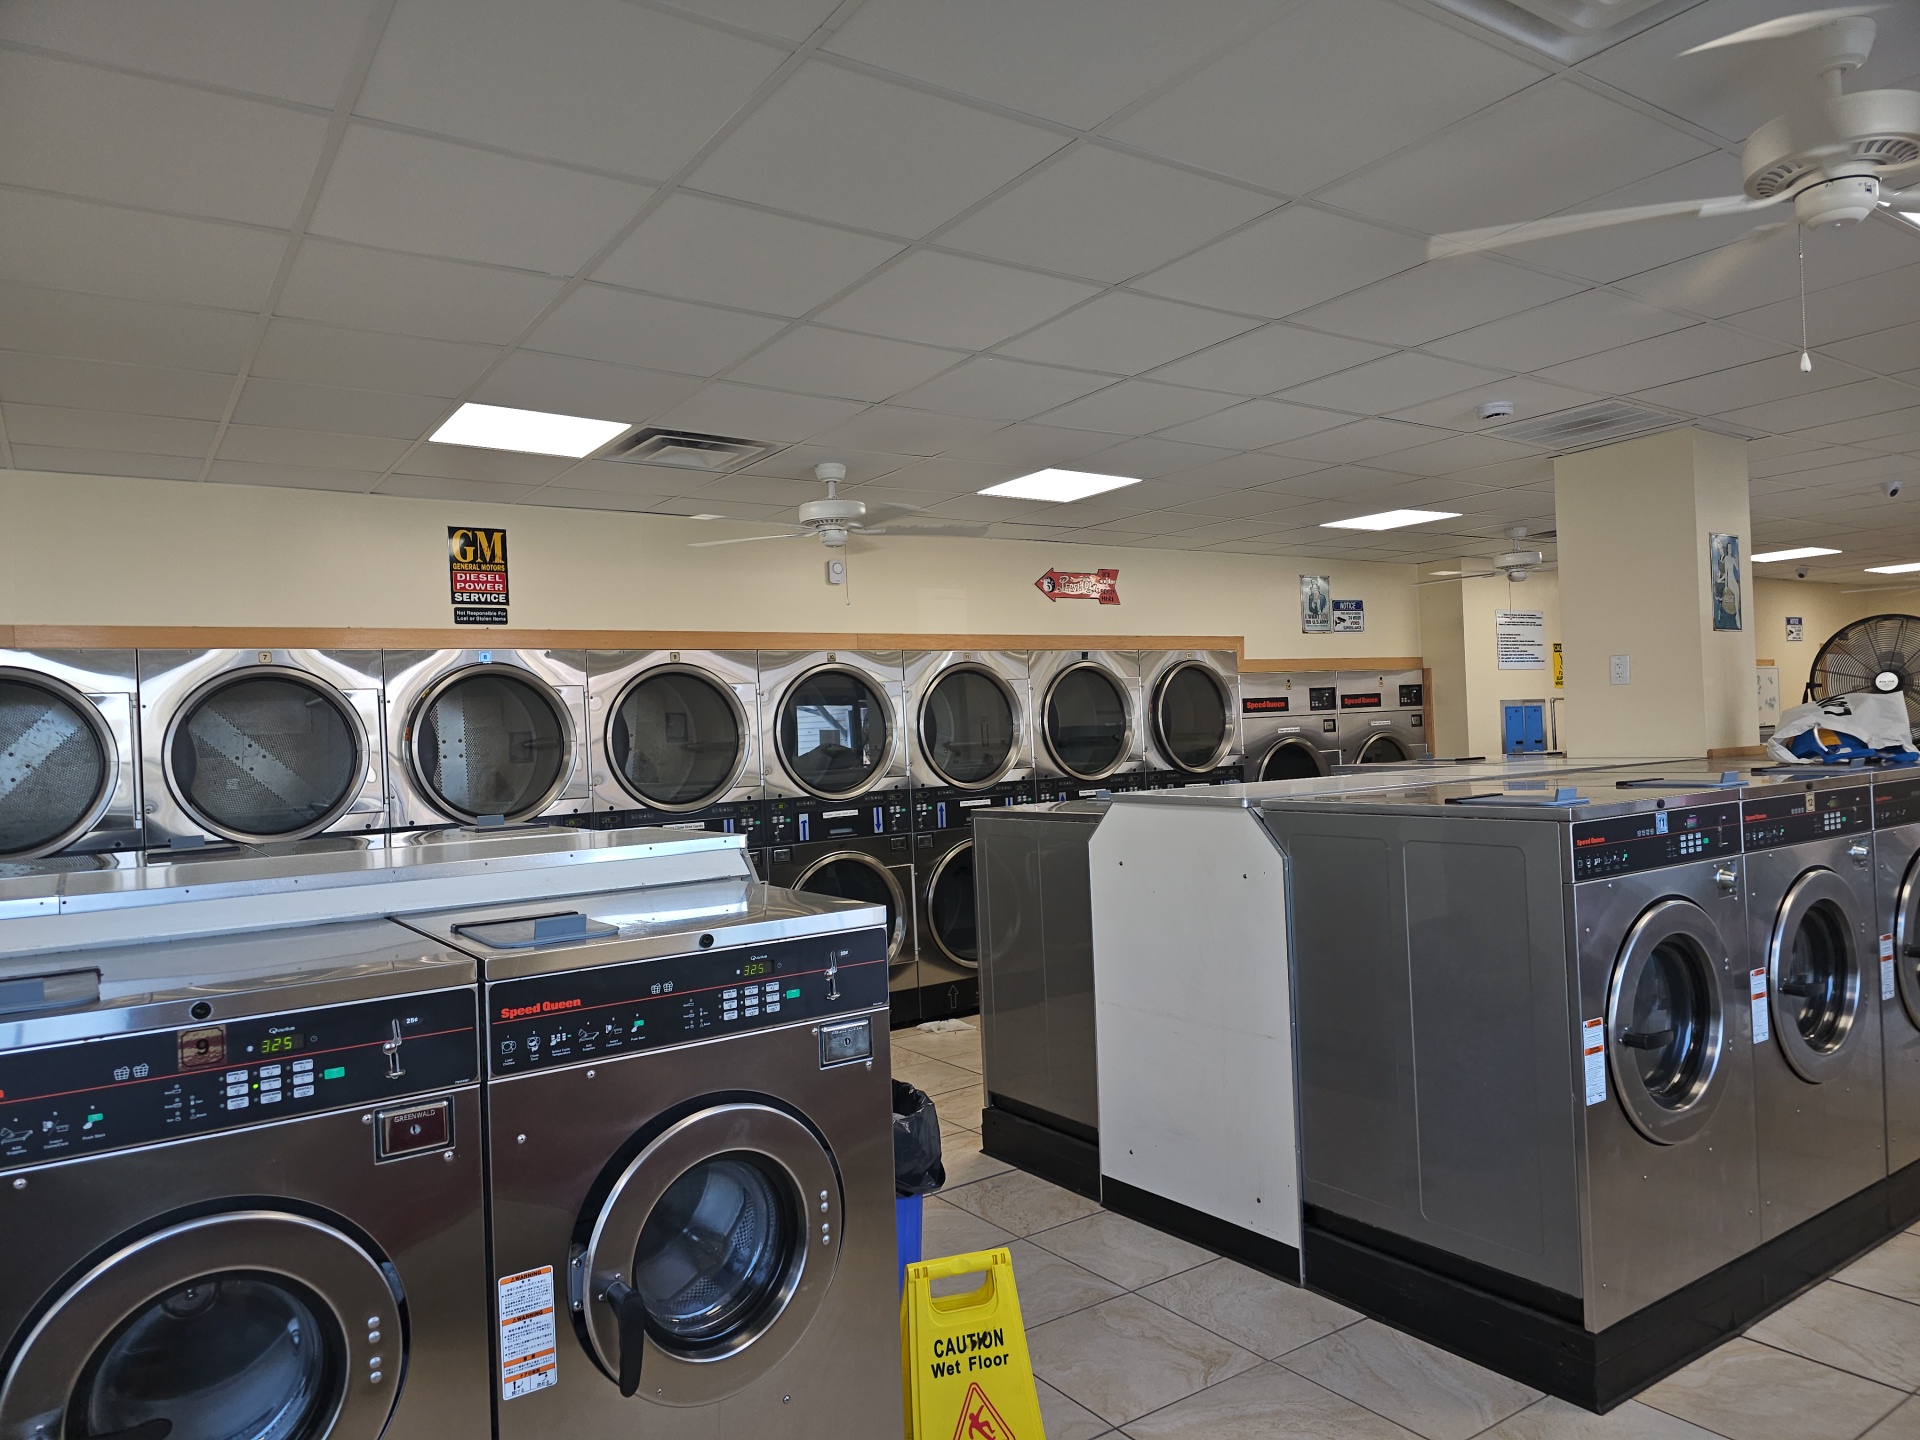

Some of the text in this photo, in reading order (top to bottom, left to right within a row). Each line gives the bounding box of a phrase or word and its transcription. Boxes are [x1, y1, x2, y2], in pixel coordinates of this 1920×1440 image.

[452, 529, 505, 564] GM
[452, 562, 480, 571] GENERAL
[456, 573, 502, 582] DIESEL
[456, 582, 503, 591] POWER
[454, 592, 506, 602] SERVICE
[1246, 701, 1266, 710] Speed
[1658, 818, 1665, 827] 11
[1576, 837, 1591, 846] Speed
[744, 964, 764, 976] 325
[501, 998, 581, 1019] Speed Queen
[196, 1038, 209, 1055] 9
[262, 1036, 292, 1053] 325
[394, 1110, 435, 1122] GREENWALD
[515, 1270, 542, 1281] WARNING
[517, 1310, 543, 1321] WARNING
[934, 1328, 1004, 1358] CAUTION
[931, 1354, 1009, 1378] Wet Floor
